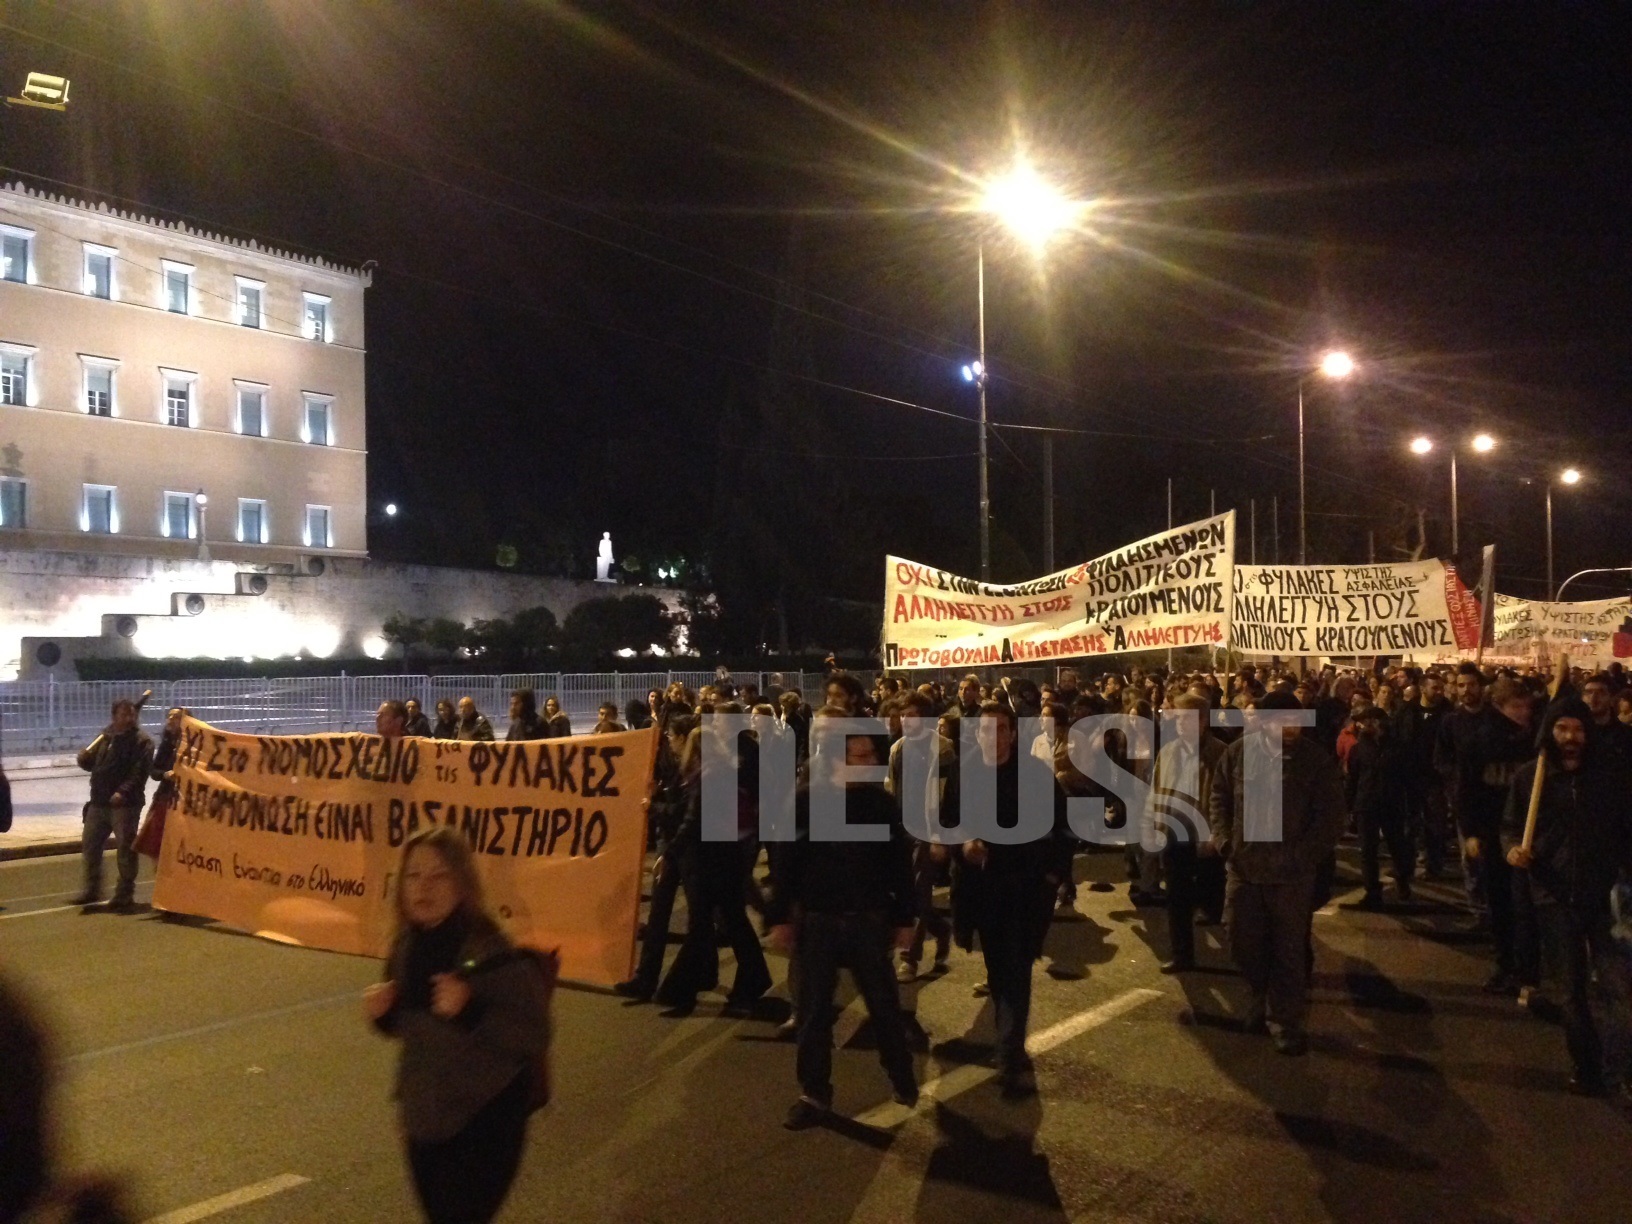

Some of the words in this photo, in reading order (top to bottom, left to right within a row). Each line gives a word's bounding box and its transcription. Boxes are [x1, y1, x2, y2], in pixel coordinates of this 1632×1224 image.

[893, 593, 1015, 624] ΑΛΛΗΛΕΓΓΥΗ
[1017, 595, 1074, 618] ΣΤΟΥΣ
[1087, 552, 1217, 597] ΠΟΛΙΤΙΚΟΥΣ
[896, 562, 935, 588] ΟΧΙ
[1258, 568, 1340, 595] ΦΥΛΑΚΕΣ
[1342, 565, 1397, 581] ΥΨΙΣΤΗΣ
[1346, 575, 1417, 593] ΑΣΦΑΛΕΙΑΣ
[1085, 581, 1225, 625] ΚΡΑΤΟΥΜΕΝΟΥΣ
[1234, 594, 1340, 624] ΛΛΗΛΕΓΓΥΗ
[1341, 588, 1420, 623] ΣΤΟΥΣ
[1541, 606, 1596, 626] ΥΨΙΣΤΗΣ
[884, 642, 1001, 668] ΠΡΩΤΟΒΟΥΛΙΑ
[1001, 633, 1107, 663] ΑΝΤΙΣΤΑΣΗΣ
[1113, 620, 1223, 651] ΑΛΛΗΛΕΓΓΥΗΣ
[1231, 623, 1310, 652] ΟΛΙΤΙΚΟΥΣ
[1315, 618, 1453, 652] ΚΡΑΤΟΥΜΕΝΟΥΣ
[257, 736, 420, 785] ΝΟΜΟΣΧΕΔΙΟ
[468, 741, 625, 797] ΦΥΛΑΚΕΣ
[434, 765, 458, 784] τις
[314, 801, 374, 844] ΕΙΝΑΙ
